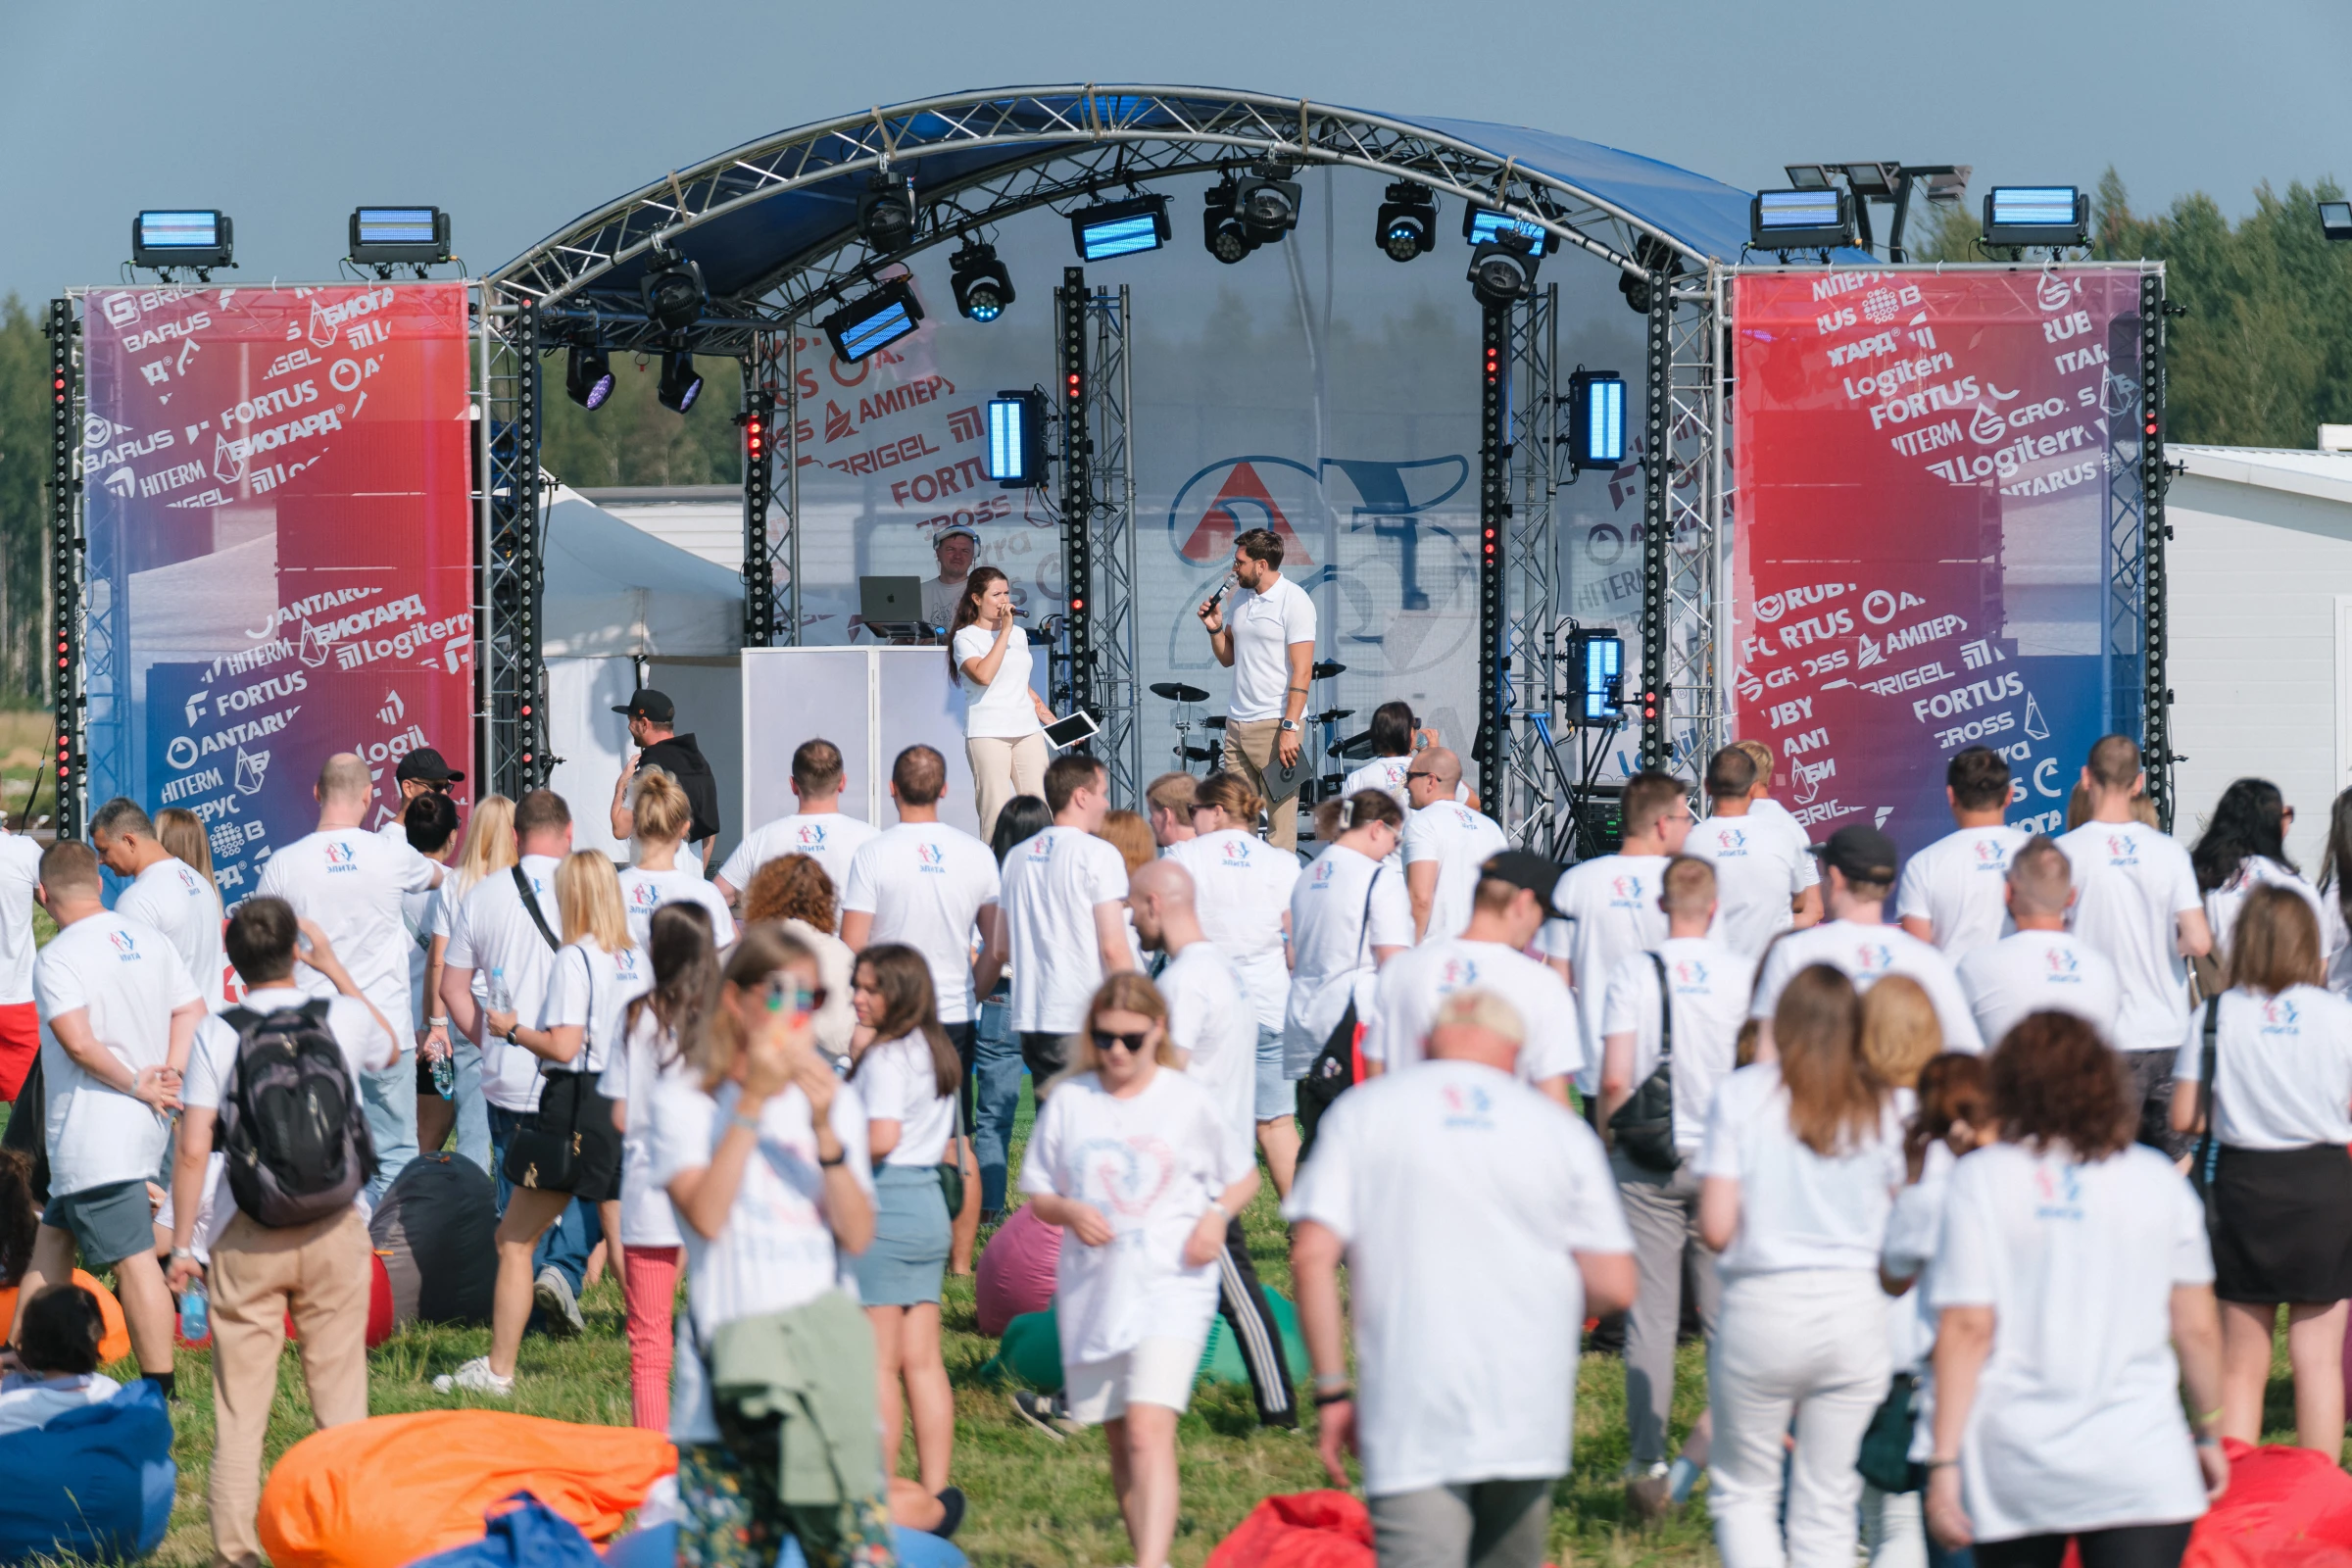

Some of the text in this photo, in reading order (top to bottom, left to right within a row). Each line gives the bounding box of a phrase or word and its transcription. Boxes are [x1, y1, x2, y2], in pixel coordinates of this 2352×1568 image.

[122, 311, 212, 353] BARUS
[220, 379, 318, 430] FORTUS
[1869, 374, 1981, 430] FORTUS
[82, 429, 174, 474] BARUS
[139, 459, 208, 498] HITERM
[312, 593, 426, 646] БИОГАРД
[226, 636, 294, 676] HITERM
[216, 670, 308, 717] FORTUS
[1912, 670, 2024, 723] FORTUS
[161, 767, 224, 804] HITERM
[327, 863, 358, 873] ЭЛИТА
